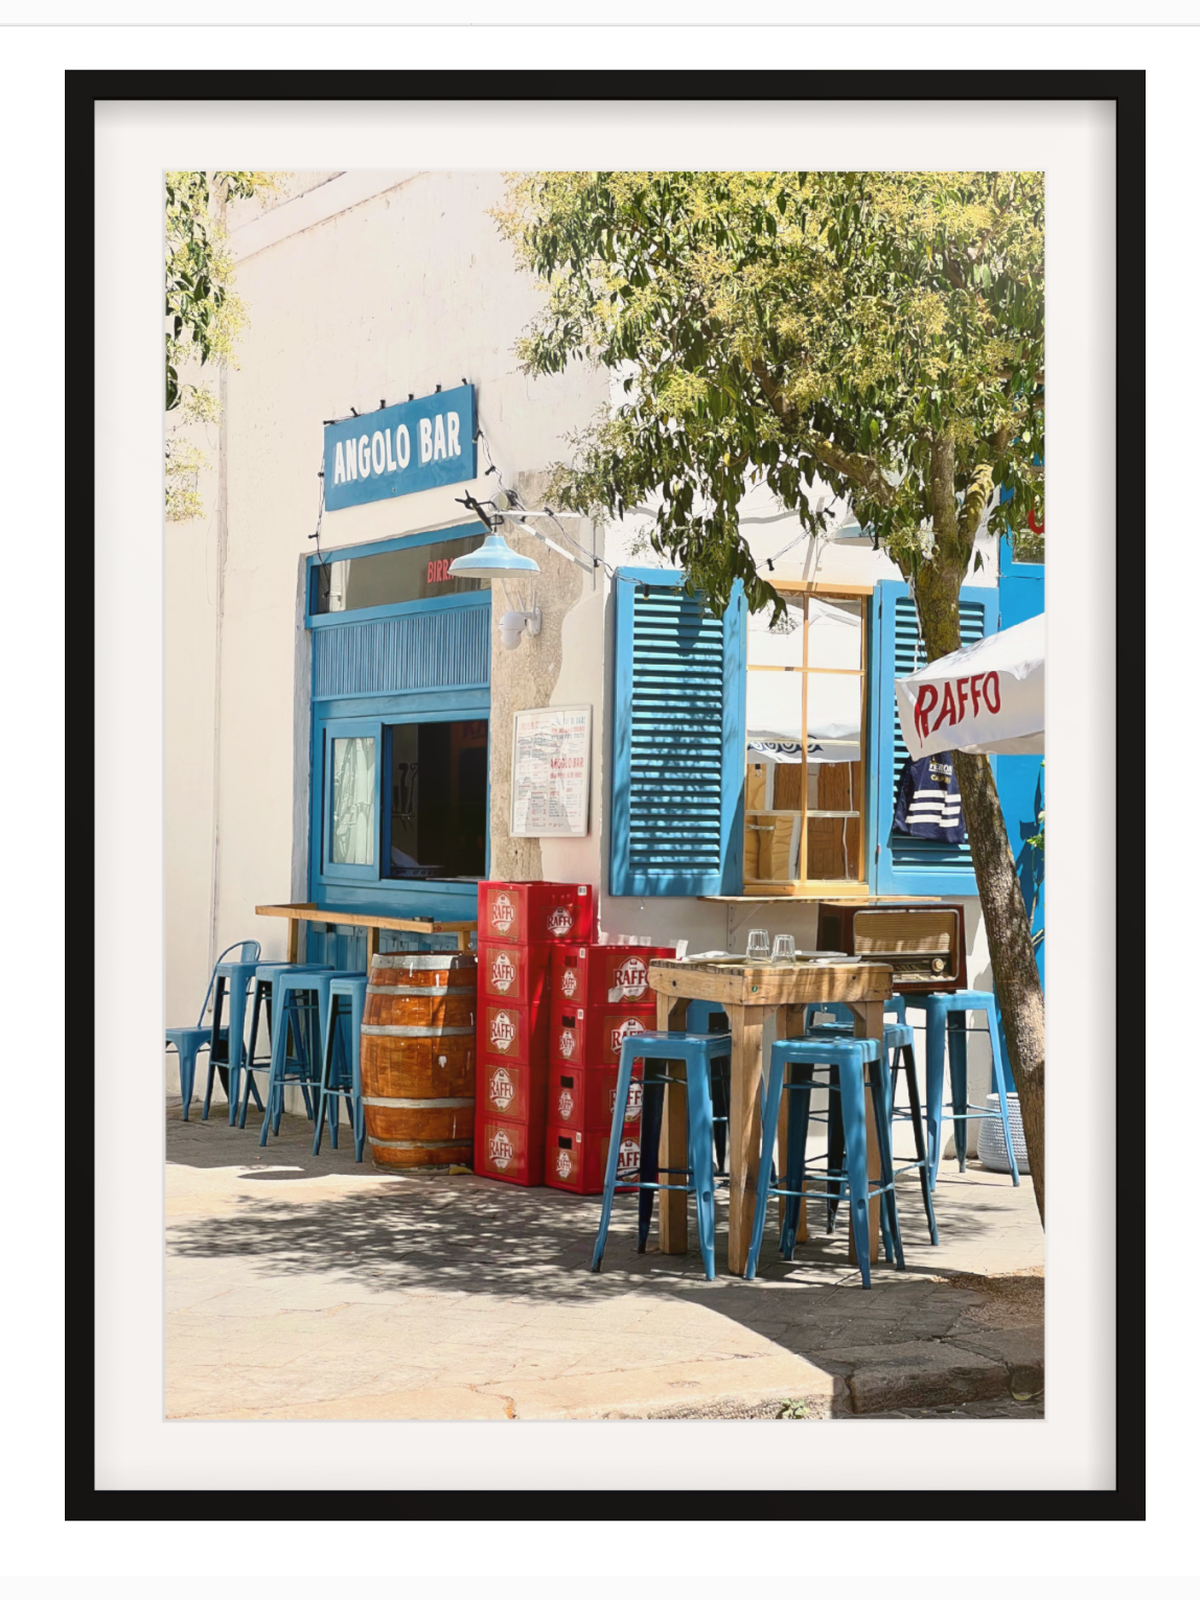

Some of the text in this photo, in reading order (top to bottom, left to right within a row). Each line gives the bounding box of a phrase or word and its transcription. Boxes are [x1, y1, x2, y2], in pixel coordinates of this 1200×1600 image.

[333, 411, 462, 485] ANGOLO BAR
[914, 670, 1001, 748] RAFFO
[491, 904, 515, 921] RAFFO
[548, 915, 573, 927] RAFFO
[491, 962, 515, 980] RAFFO
[490, 1021, 515, 1039] RAFFO
[490, 1079, 515, 1098] RAFFO
[489, 1139, 514, 1158] RAFFO
